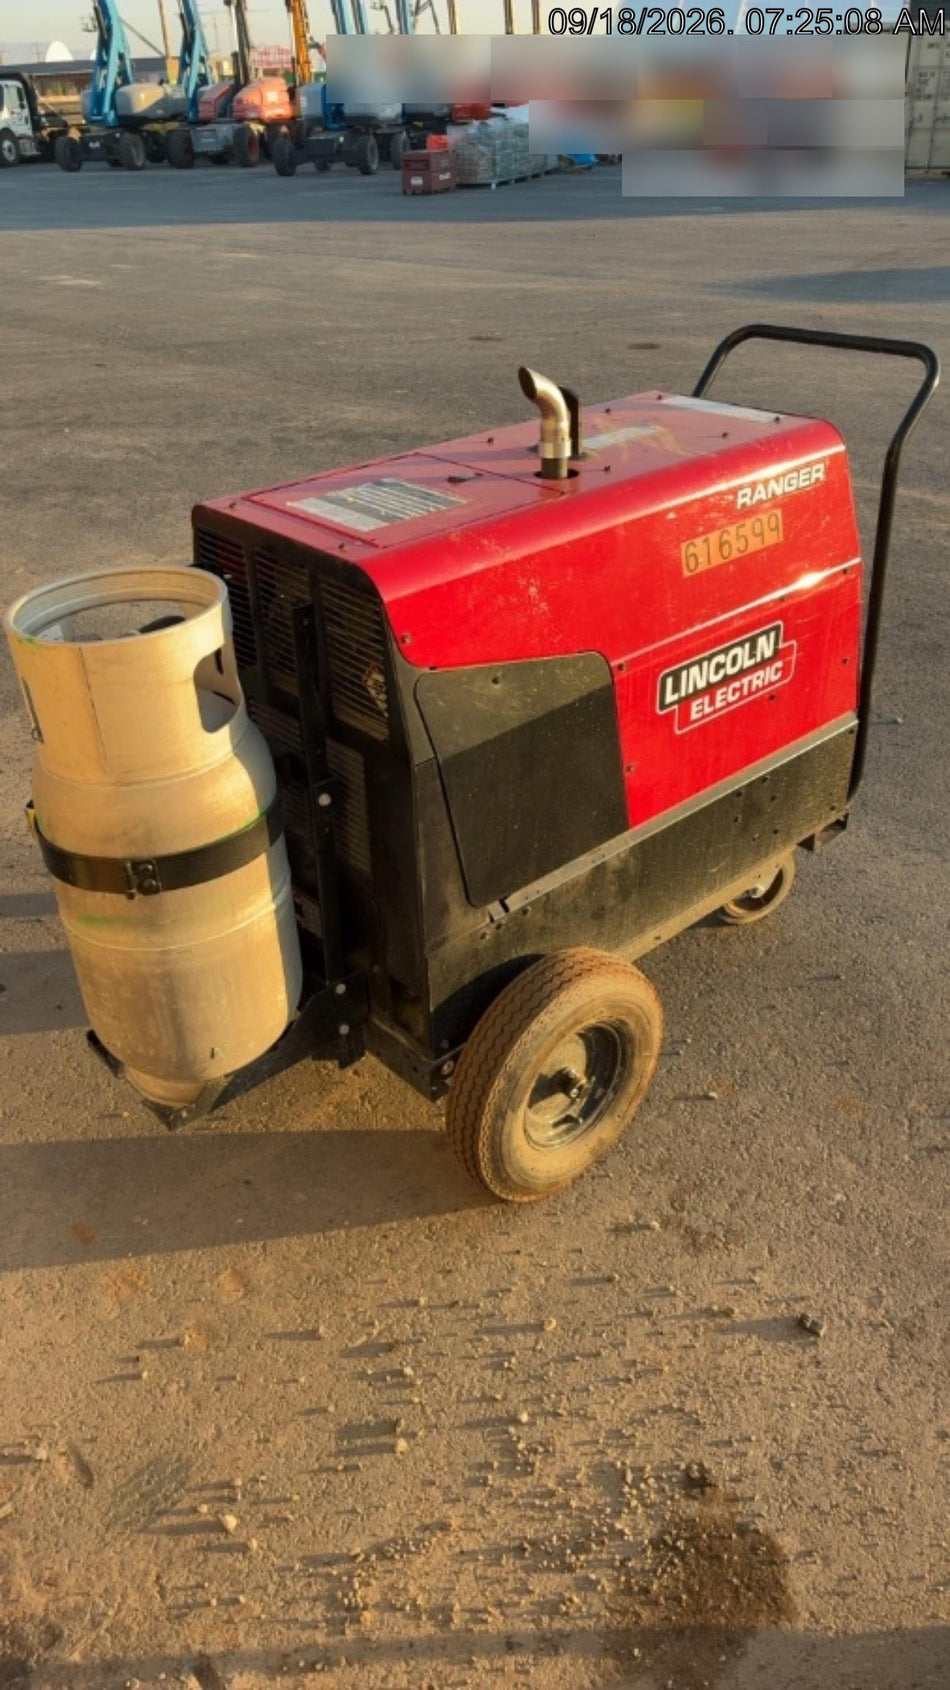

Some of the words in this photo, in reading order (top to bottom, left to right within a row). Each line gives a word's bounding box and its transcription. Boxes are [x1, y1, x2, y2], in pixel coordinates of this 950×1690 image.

[736, 463, 825, 509] RANGER
[684, 512, 780, 573] 616599
[665, 630, 777, 705] LINCOLN
[690, 660, 783, 720] ELECTRIC
